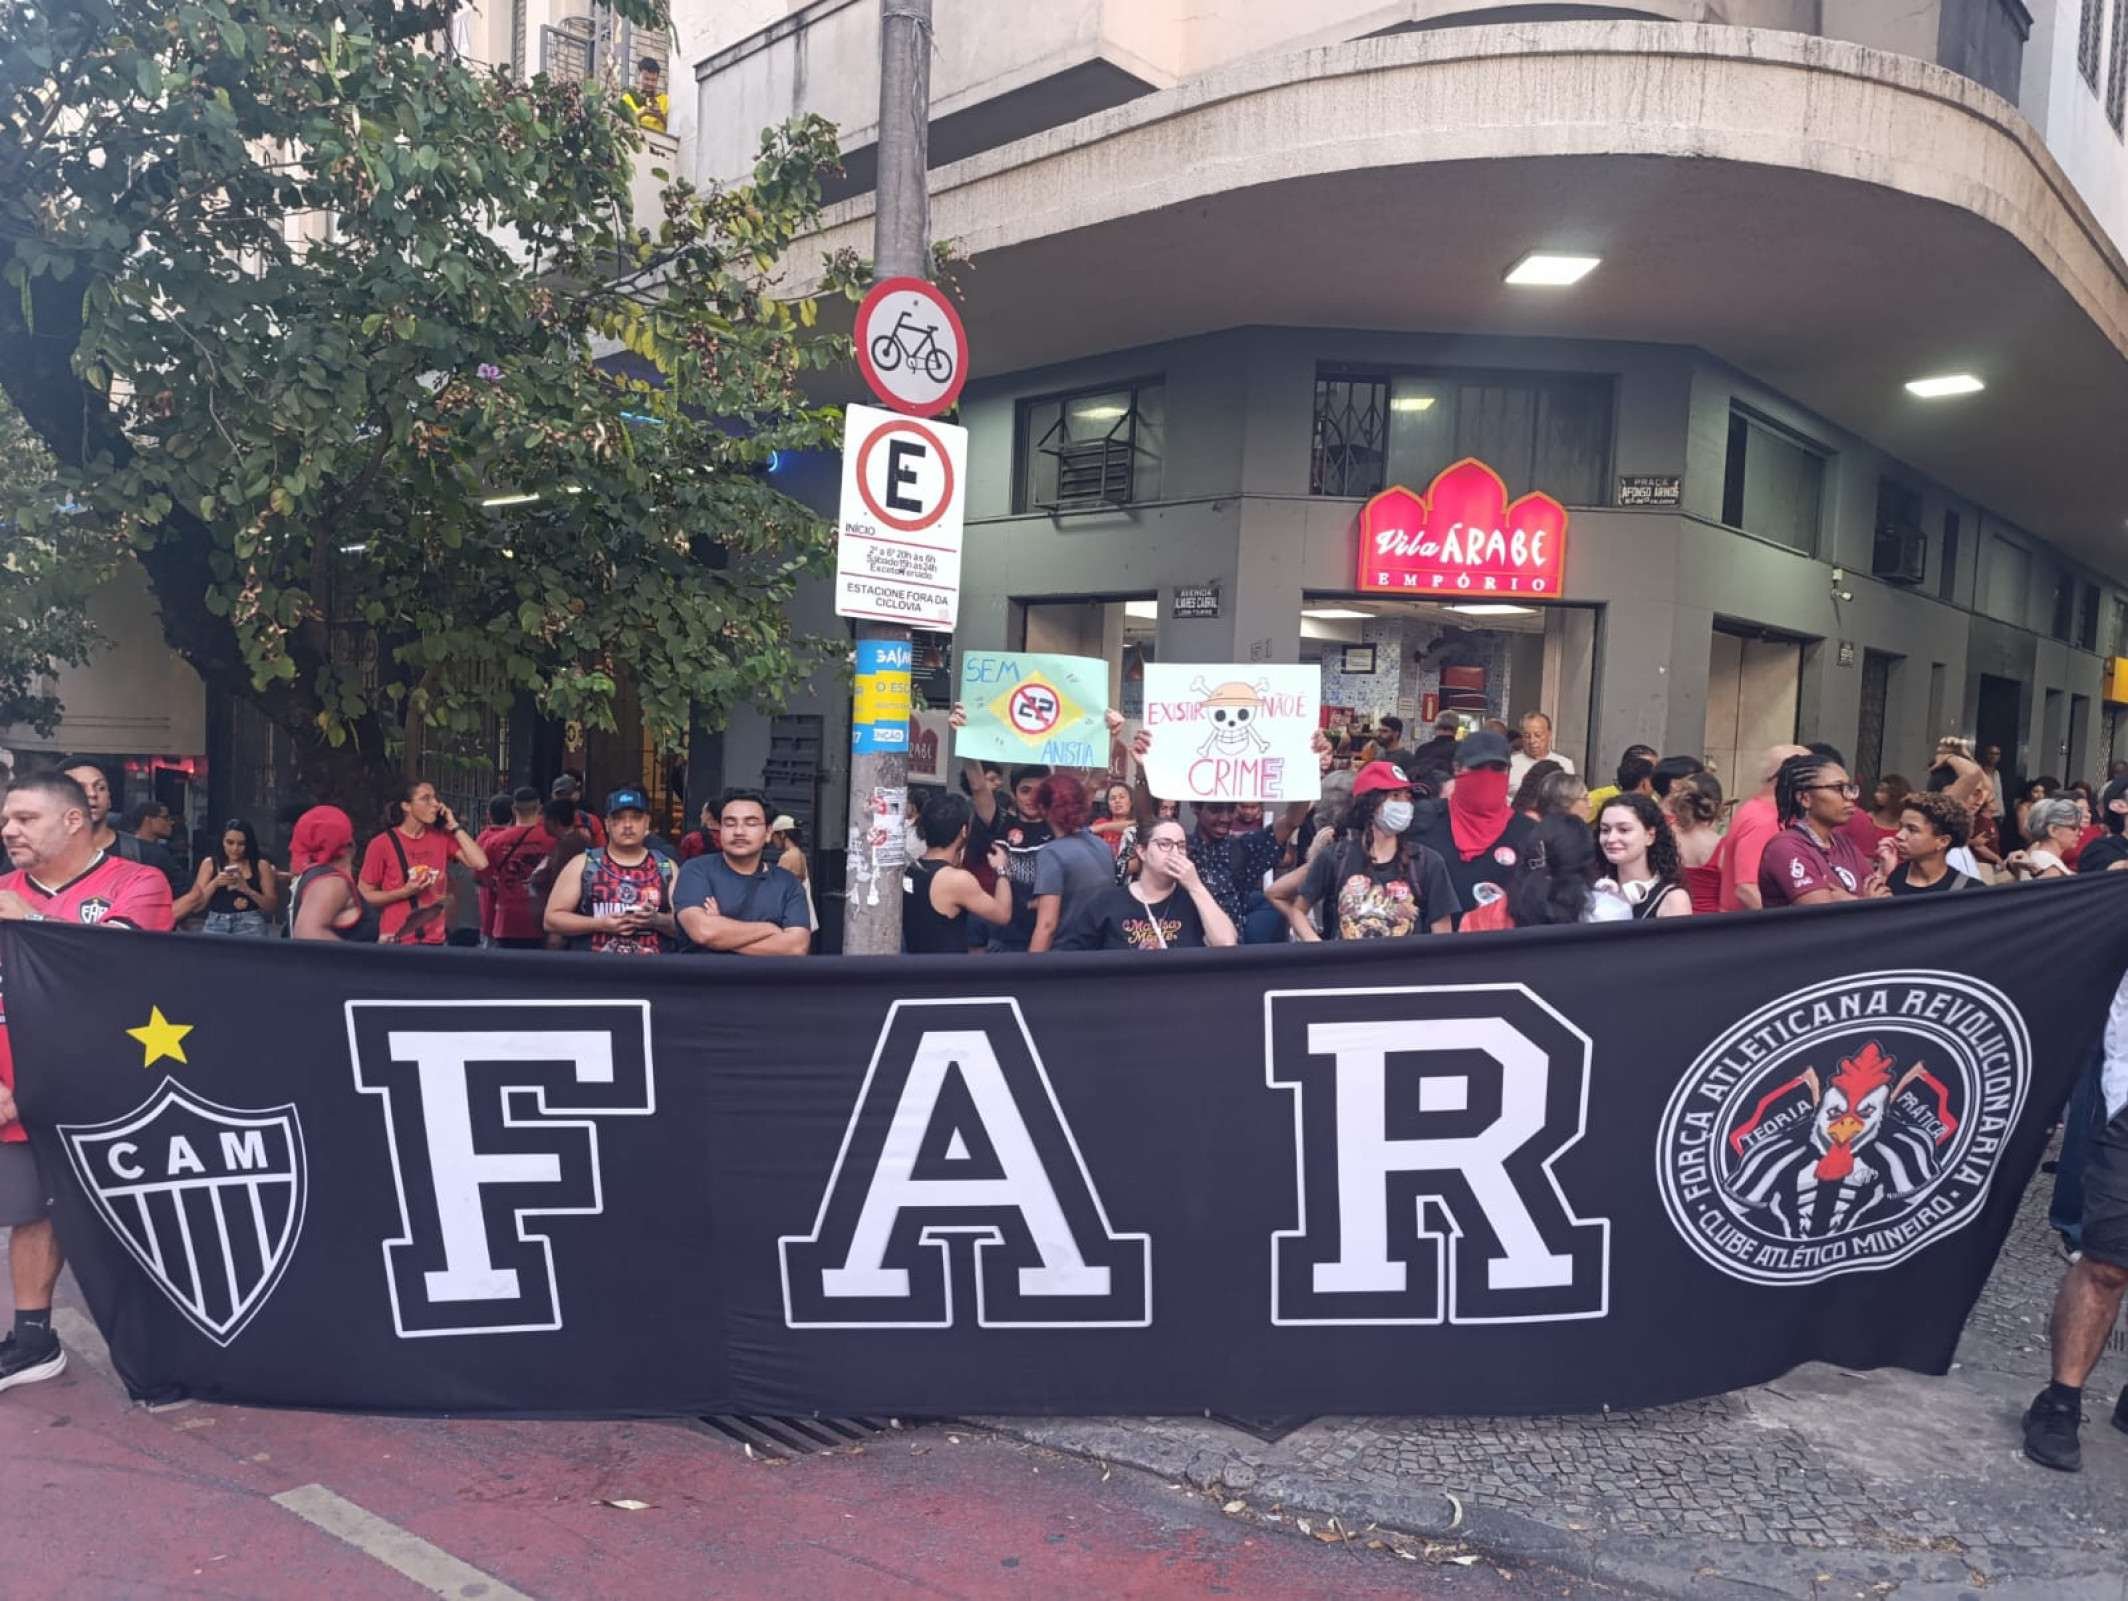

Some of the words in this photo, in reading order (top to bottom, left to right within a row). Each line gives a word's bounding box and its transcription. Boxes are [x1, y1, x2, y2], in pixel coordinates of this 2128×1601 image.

[886, 438, 926, 513] E
[845, 522, 876, 536] INÍCIO
[1375, 528, 1440, 558] Vila
[1440, 522, 1547, 566] ÁRABE
[847, 583, 905, 600] ESTACIONE
[906, 591, 933, 603] FORA
[934, 595, 949, 606] DA
[1378, 571, 1546, 591] EMPÓRIO
[875, 598, 922, 612] CICLOVIA
[965, 658, 1021, 683] SEM
[1148, 700, 1206, 725] EXISTIR
[1188, 757, 1285, 799] CRIME
[1677, 1110, 1714, 1202] FORÇA
[1699, 989, 1889, 1101] ATLETICANA
[1898, 988, 2013, 1188] REVOLUCIONÁRIA
[1896, 1091, 1949, 1141] PRÁTICA
[1740, 1100, 1813, 1148] TEORIA
[108, 1126, 270, 1179] CAM
[1699, 1209, 1759, 1262] CLUBE
[1754, 1241, 1847, 1269] ATLÉTICO
[1853, 1194, 1956, 1256] MINEIRO
